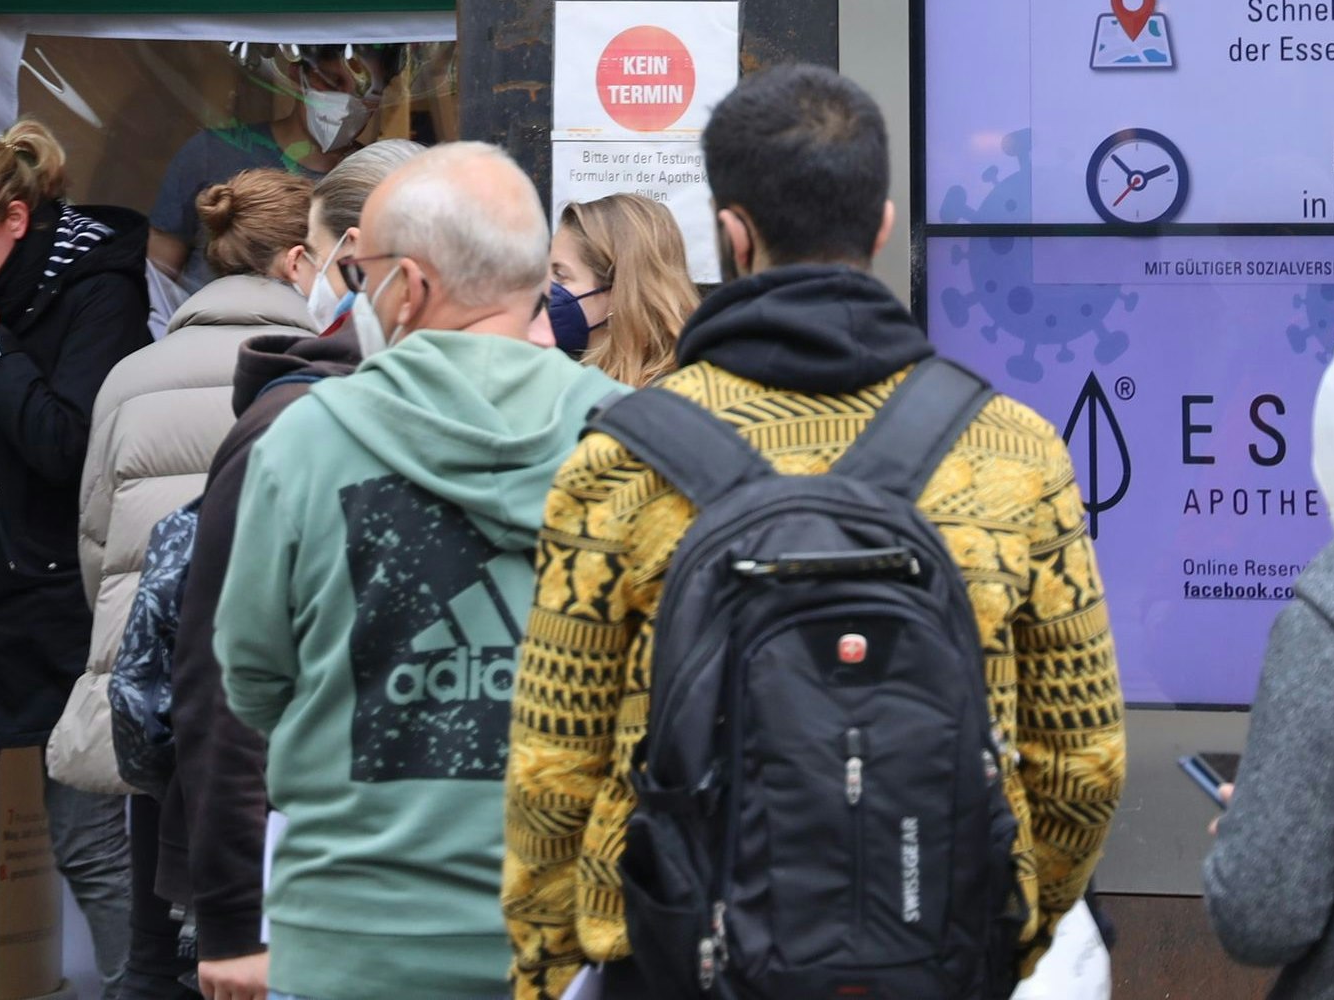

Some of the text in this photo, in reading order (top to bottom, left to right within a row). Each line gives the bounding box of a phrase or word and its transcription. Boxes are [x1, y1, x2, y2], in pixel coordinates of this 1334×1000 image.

[1229, 36, 1273, 63] der
[623, 55, 668, 76] KEIN
[607, 84, 683, 105] TERMIN
[582, 150, 701, 167] Bitte vor der Testung
[569, 169, 708, 185] Formular in der Apothek
[1303, 190, 1326, 219] in
[1144, 261, 1170, 275] MIT
[1175, 258, 1242, 276] GÜLTIGER
[1183, 488, 1320, 517] APOTHE
[1183, 558, 1307, 577] Online Reserv
[1183, 581, 1296, 600] facebook.co
[902, 816, 921, 923] SWISSGEAR
